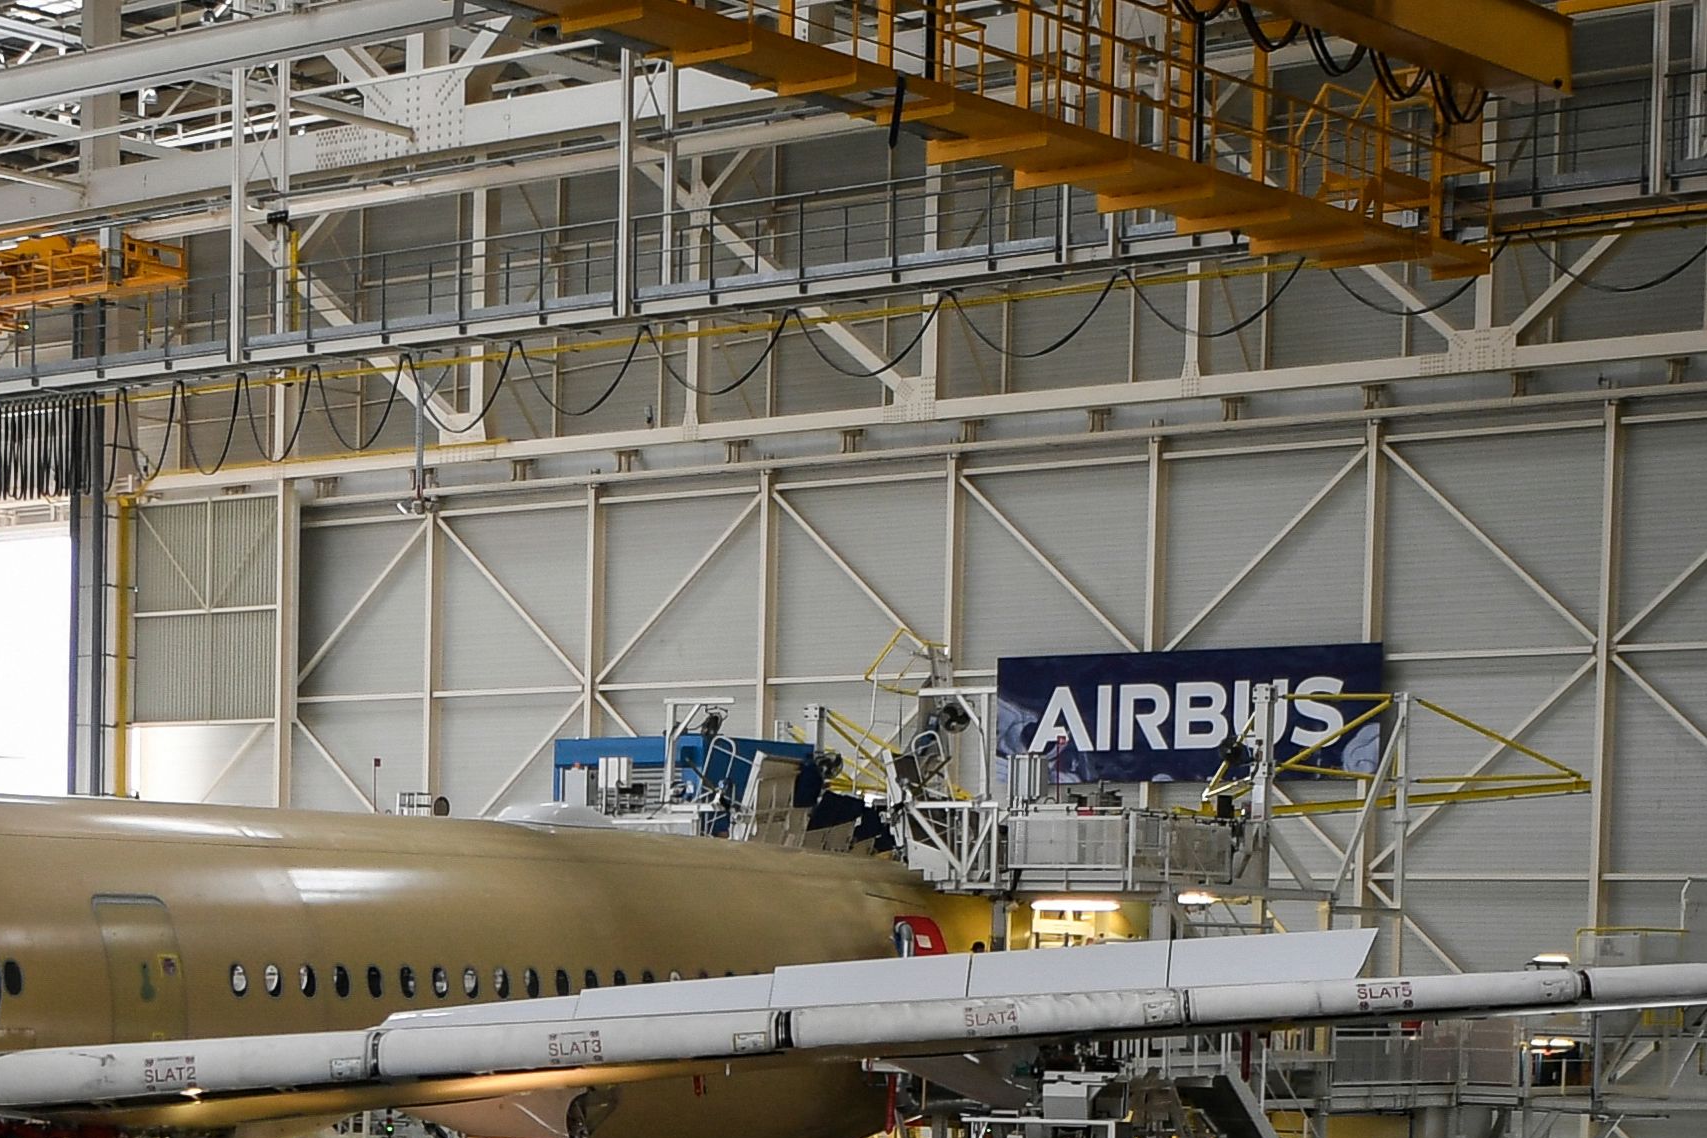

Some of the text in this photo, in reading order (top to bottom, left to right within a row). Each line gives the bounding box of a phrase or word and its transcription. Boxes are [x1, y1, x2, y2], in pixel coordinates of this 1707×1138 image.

[1028, 676, 1345, 753] AIRBUS
[1356, 986, 1413, 1000] SLAT5
[965, 1010, 1018, 1027] SLAT4
[548, 1039, 602, 1057] SLAT3
[144, 1066, 196, 1083] SLAT2
